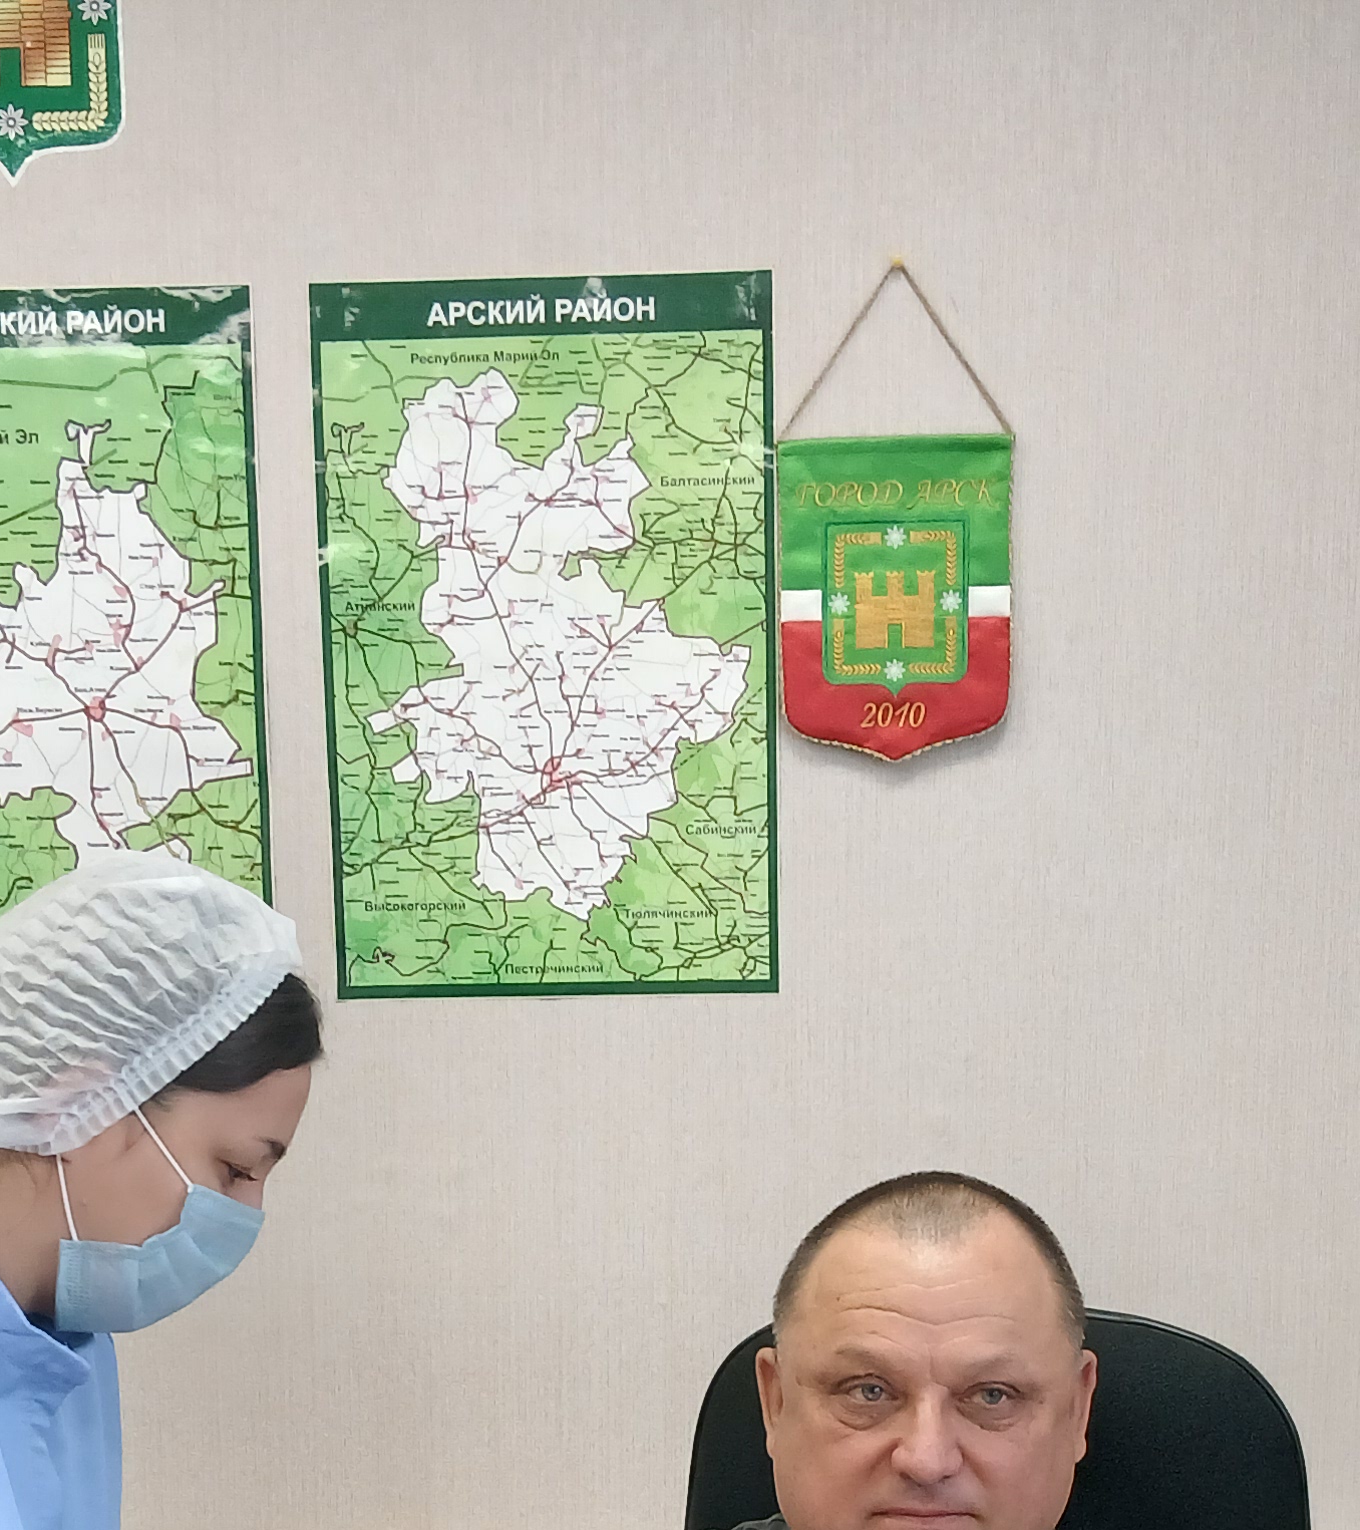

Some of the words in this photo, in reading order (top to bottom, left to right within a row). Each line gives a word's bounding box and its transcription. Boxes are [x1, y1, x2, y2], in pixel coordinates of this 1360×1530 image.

[427, 294, 546, 327] АРСКИЙ
[555, 296, 656, 323] РАЙОН
[66, 304, 166, 335] РАЙОН
[411, 351, 490, 366] Республика
[15, 431, 40, 446] Эл
[660, 474, 755, 488] Балтасинский
[796, 480, 904, 510] ГОРОД
[906, 479, 999, 510] АРСК
[860, 701, 927, 728] 2010
[685, 822, 757, 836] Сабинский
[365, 899, 466, 914] Высокогорский
[624, 907, 713, 920] Тюлячинский
